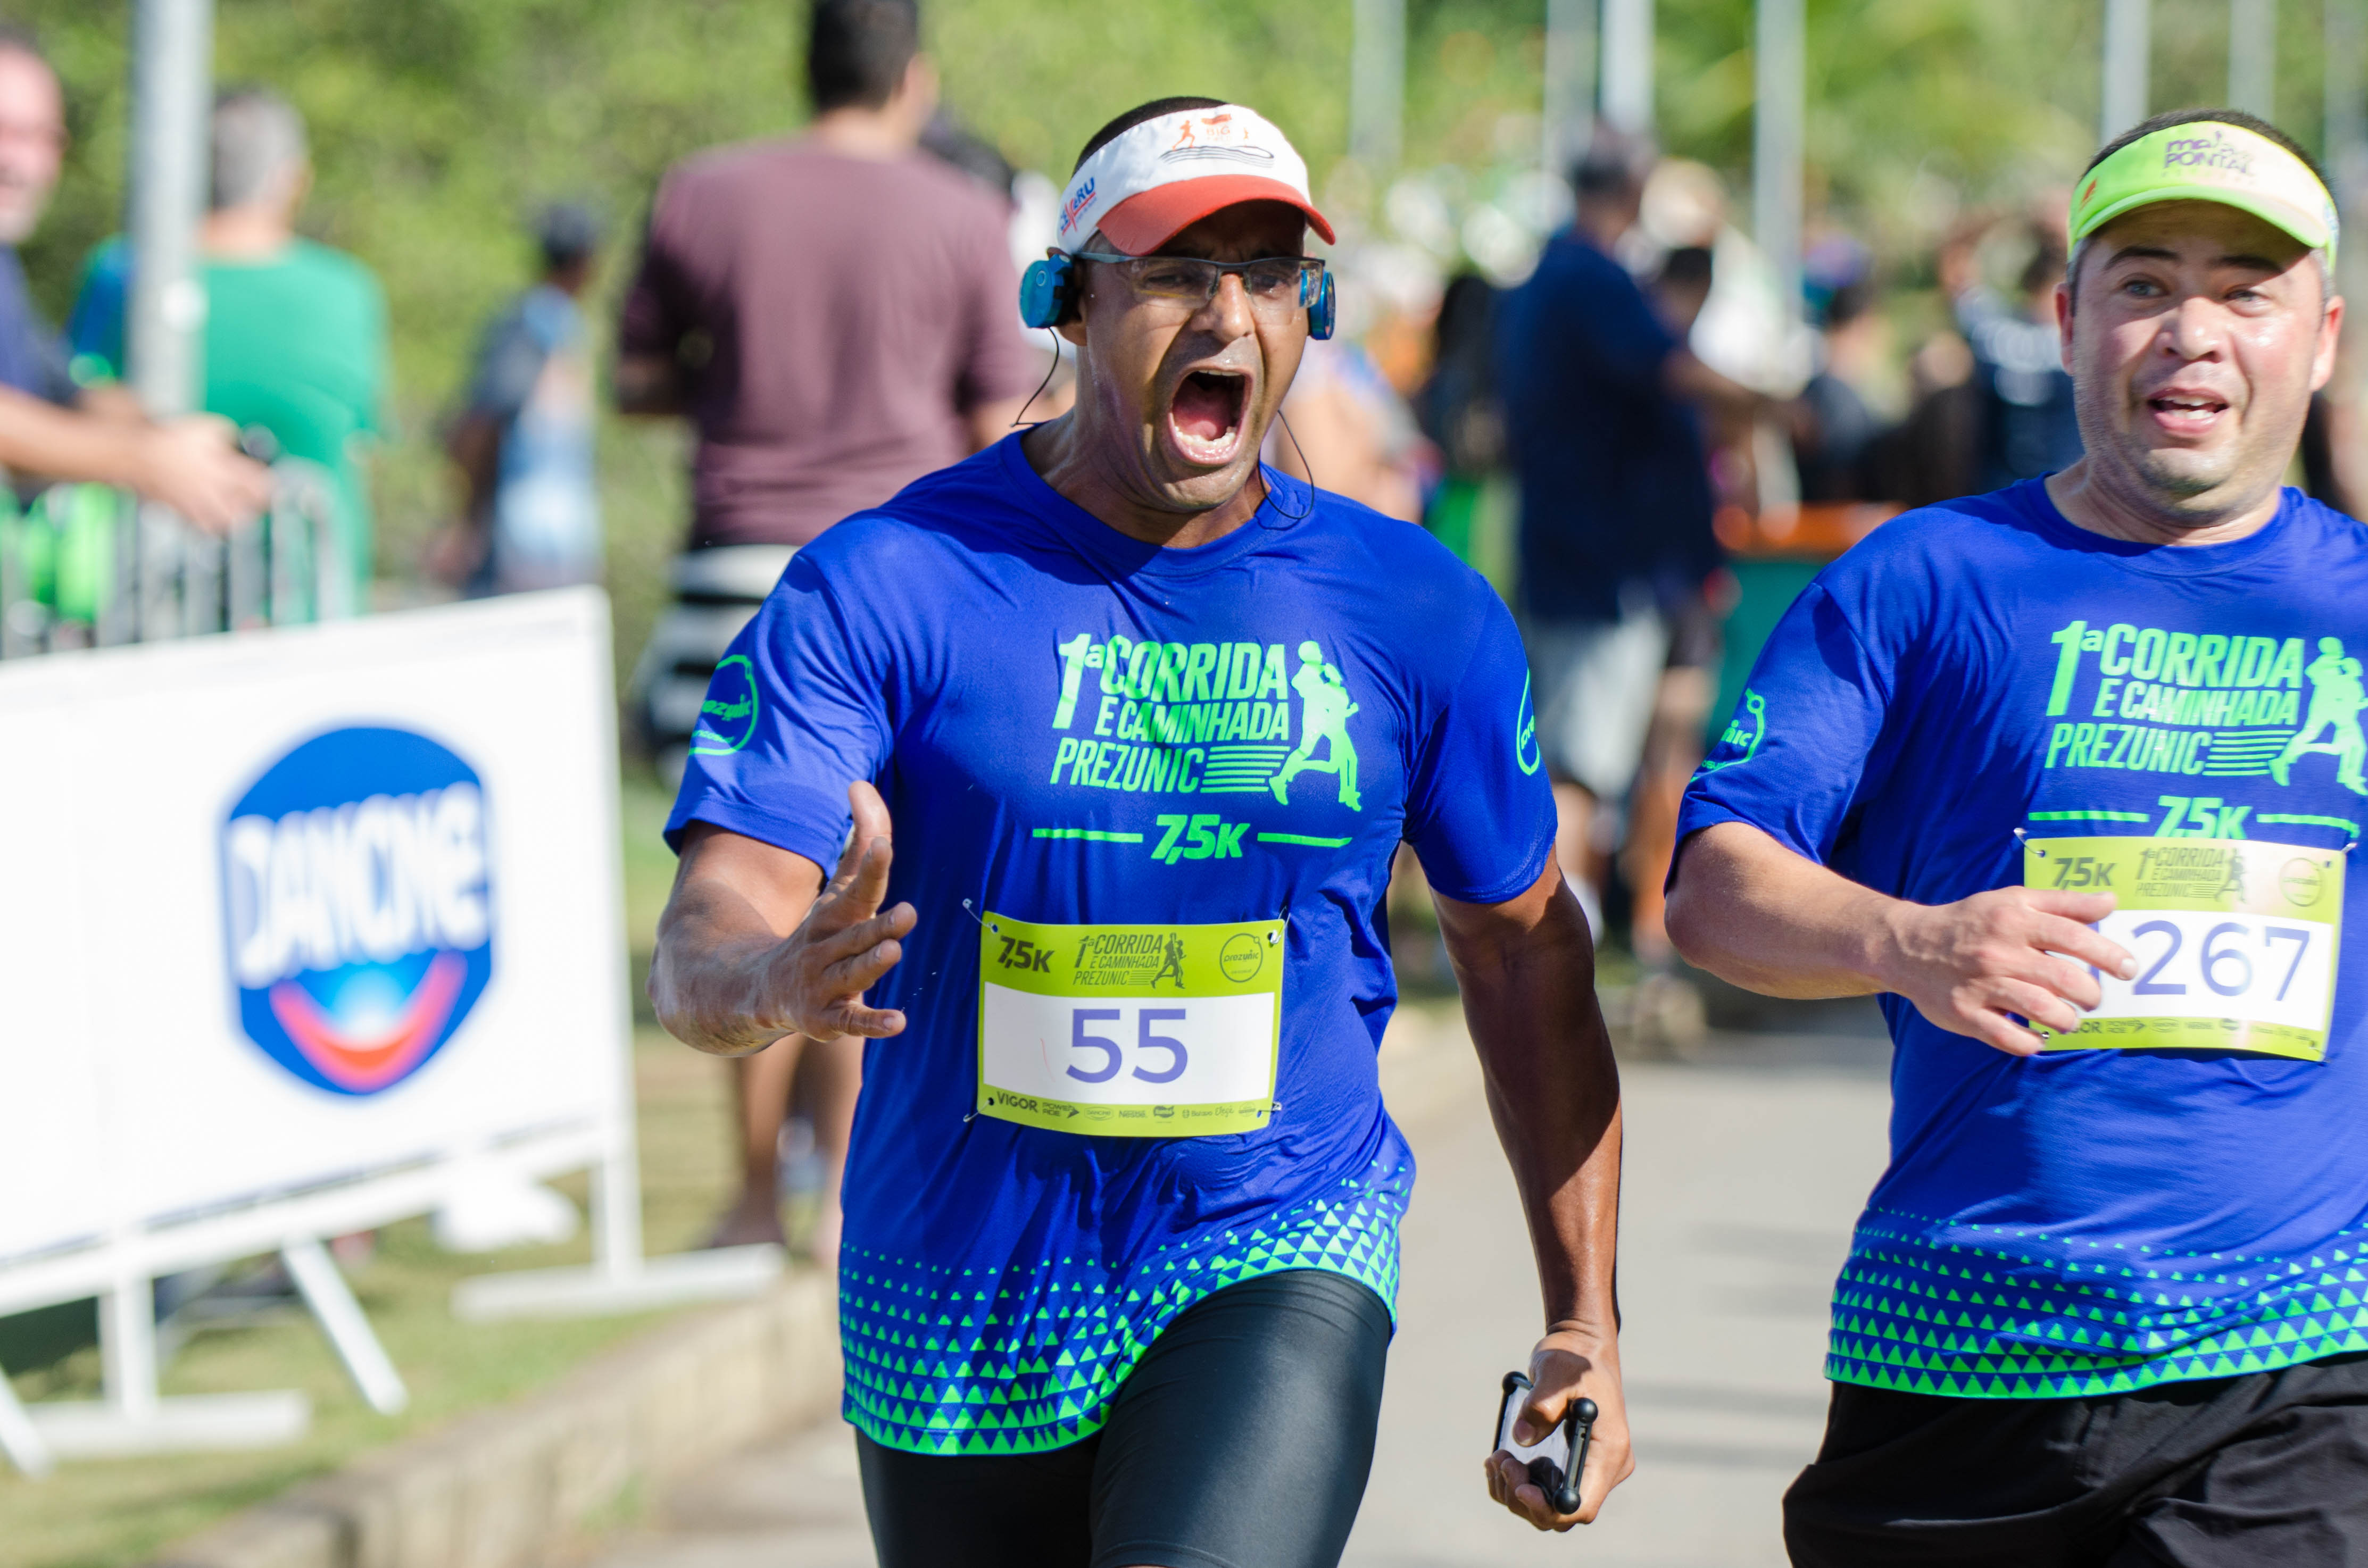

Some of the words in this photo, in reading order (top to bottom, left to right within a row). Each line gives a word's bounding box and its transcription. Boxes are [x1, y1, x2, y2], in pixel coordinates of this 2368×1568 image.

[1100, 635, 1288, 702] CORRIDA
[2099, 623, 2305, 688] CORRIDA
[1094, 696, 1119, 736] E
[1117, 700, 1289, 743] CAMINHADA
[2092, 679, 2122, 717] E
[2120, 681, 2300, 726] CAMINHADA
[1050, 737, 1204, 793] PREZUNIC
[2045, 723, 2213, 775] PREZUNIC
[1151, 814, 1250, 864] 7,5K
[2154, 847, 2225, 868] CORRIDA
[997, 936, 1057, 974] 7,5K
[1090, 956, 1098, 969] E
[1099, 955, 1159, 970] CAMINHADA
[1093, 933, 1163, 956] CORRIDA
[1073, 970, 1129, 986] PREZUNIC
[1066, 1008, 1189, 1084] 55
[996, 1091, 1038, 1113] VIGOR
